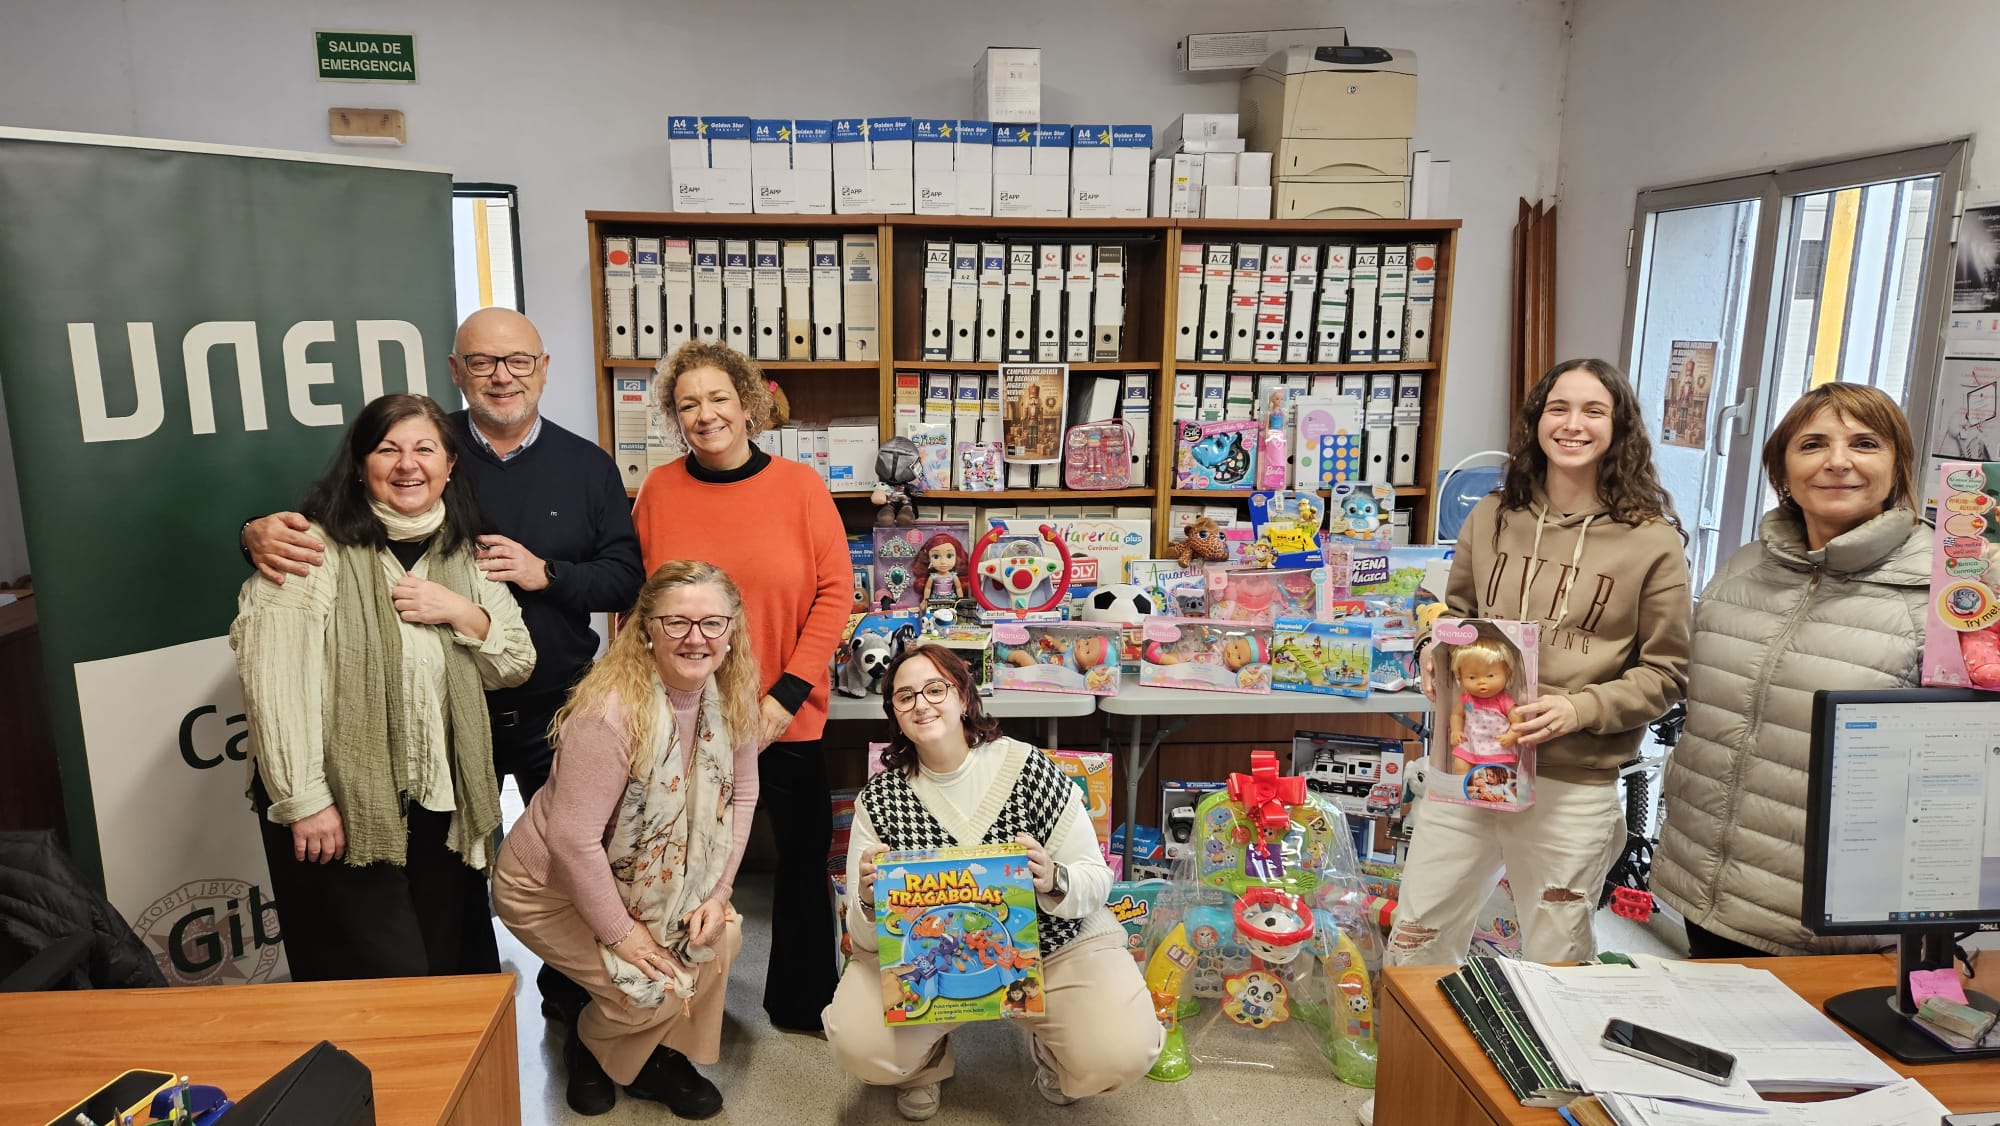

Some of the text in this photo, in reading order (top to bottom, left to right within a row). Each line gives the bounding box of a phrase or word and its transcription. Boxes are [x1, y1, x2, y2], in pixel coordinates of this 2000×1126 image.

[328, 40, 402, 55] SALIDA DE
[321, 58, 413, 73] EMERGENCIA
[673, 119, 687, 128] A4
[837, 121, 850, 130] A4
[918, 122, 931, 131] A4
[756, 125, 769, 135] A4
[997, 127, 1010, 136] A4
[1078, 129, 1091, 138] A4
[930, 252, 948, 262] A/Z
[1014, 253, 1031, 263] A/Z
[1211, 253, 1228, 265] A/Z
[1358, 254, 1376, 265] A/Z
[1387, 254, 1405, 265] A/Z
[67, 319, 428, 443] UNED
[1125, 534, 1142, 544] plus
[1352, 557, 1387, 571] RENA
[1963, 618, 1981, 628] Try
[1437, 629, 1473, 639] Nenuco
[1088, 762, 1105, 774] Diset
[904, 869, 978, 893] RANA
[889, 887, 1003, 907] TRAGABOLAS
[137, 881, 245, 932] MOBILIBVS
